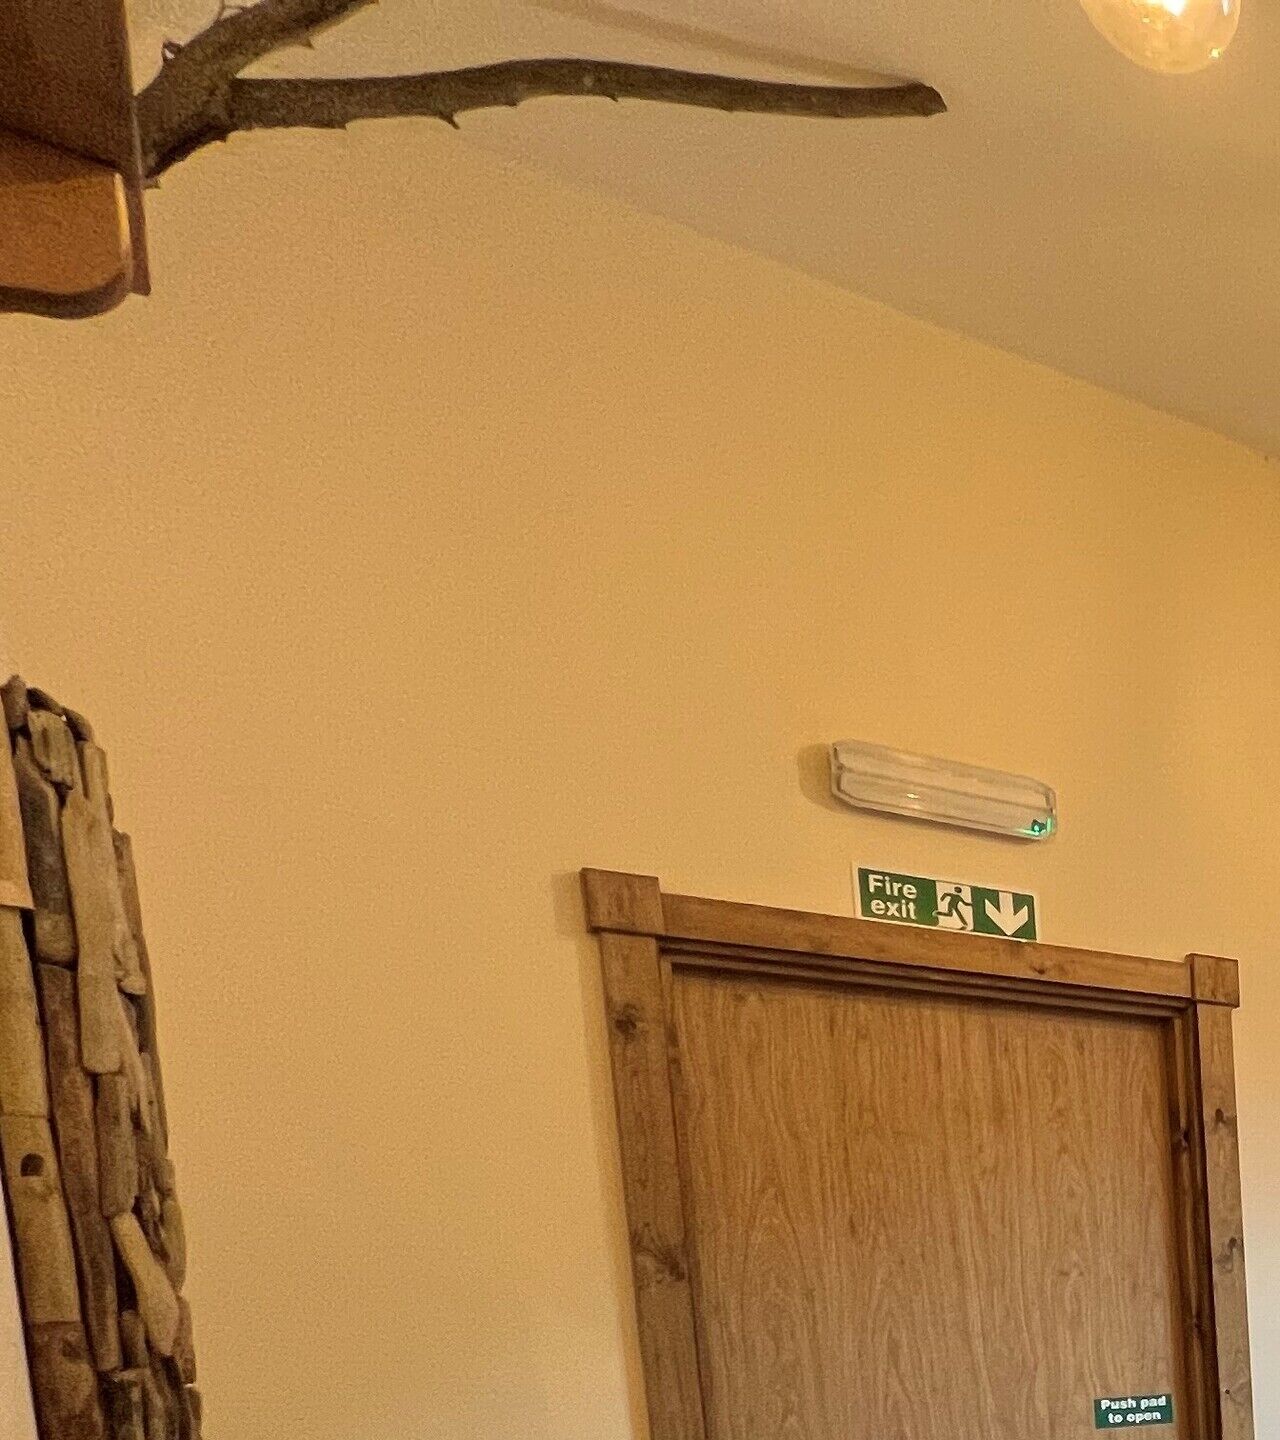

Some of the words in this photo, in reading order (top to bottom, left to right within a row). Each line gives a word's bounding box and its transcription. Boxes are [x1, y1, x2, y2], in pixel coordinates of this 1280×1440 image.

[868, 874, 917, 899] Fire
[870, 899, 917, 920] exit
[1100, 1398, 1137, 1410] Push
[1140, 1395, 1167, 1410] pad
[1108, 1412, 1123, 1424] to
[1126, 1411, 1161, 1423] open
